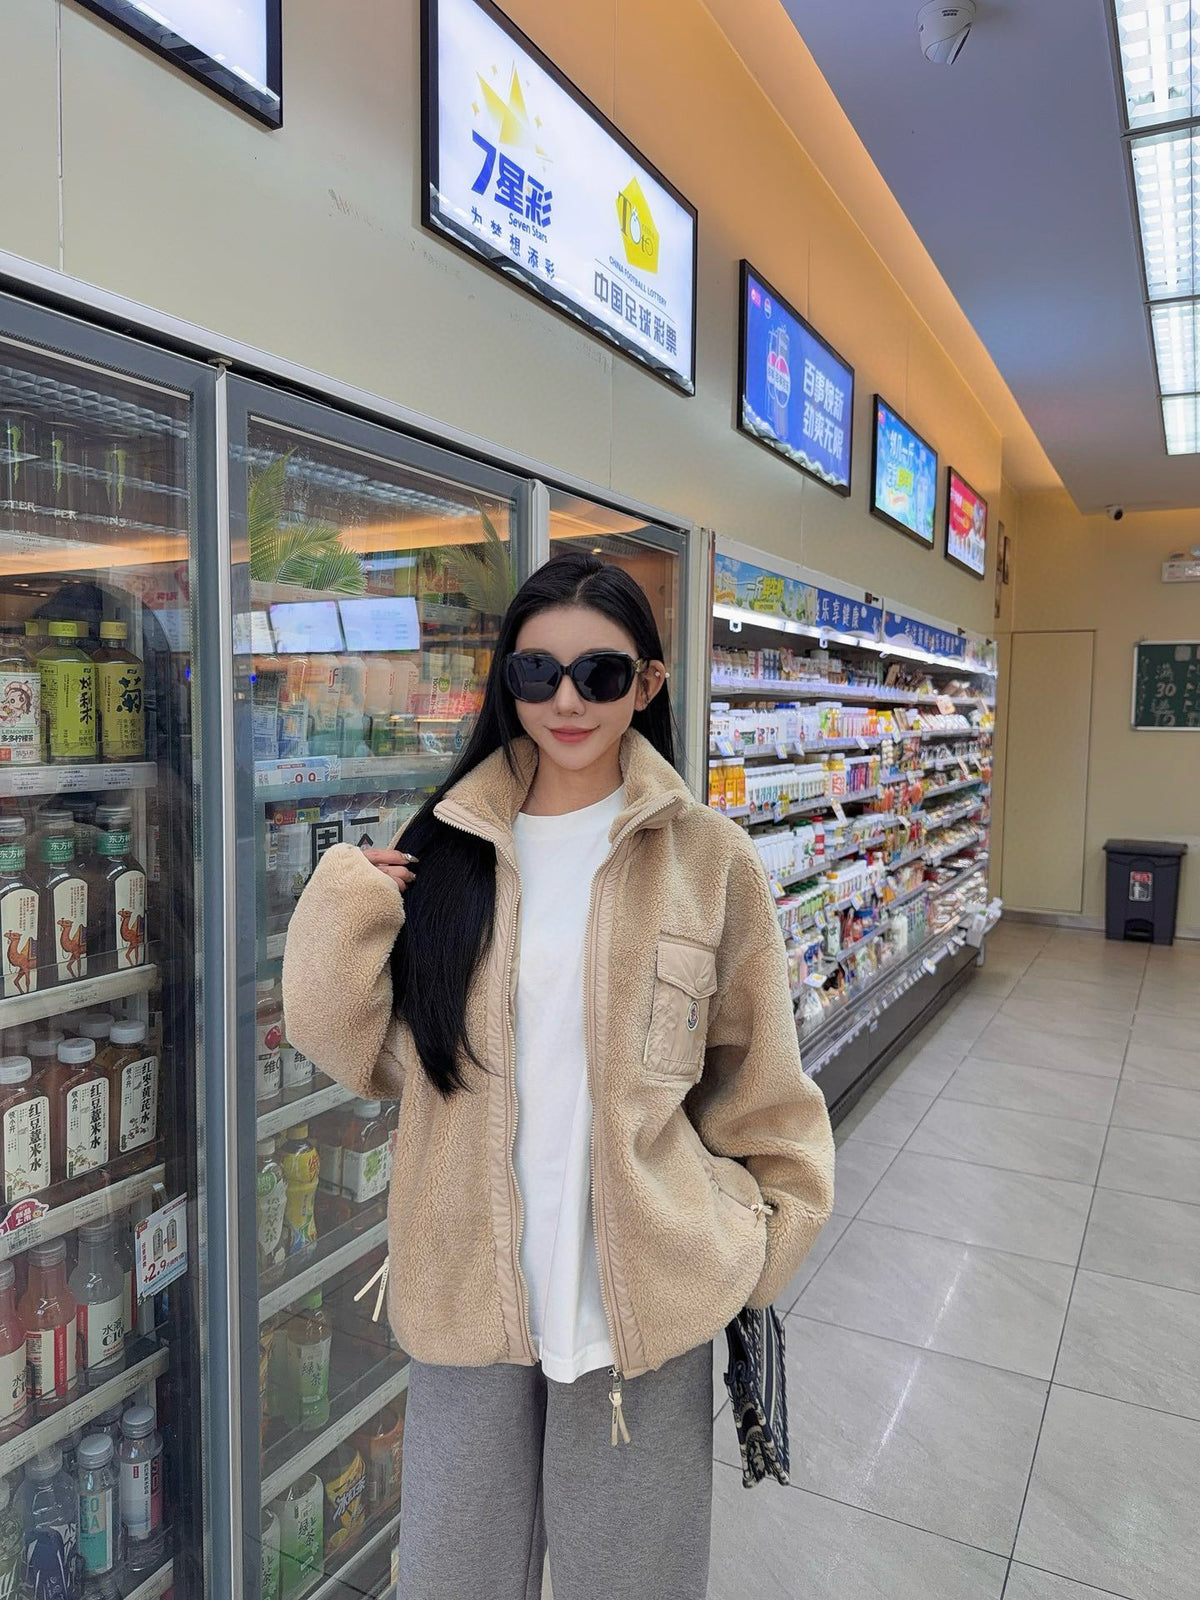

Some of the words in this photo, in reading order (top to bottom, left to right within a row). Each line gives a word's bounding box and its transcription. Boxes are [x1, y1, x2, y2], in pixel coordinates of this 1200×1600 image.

[471, 129, 553, 228] 7星彩
[471, 206, 555, 280] 为梦想添彩
[508, 212, 531, 235] Seven
[531, 225, 548, 244] Stars
[594, 270, 677, 356] 中国足球彩票
[802, 402, 844, 461] 劲爽无限
[1155, 682, 1177, 698] 30
[28, 1101, 42, 1173] 红豆薏米水
[89, 1083, 102, 1150] 红豆薏米水
